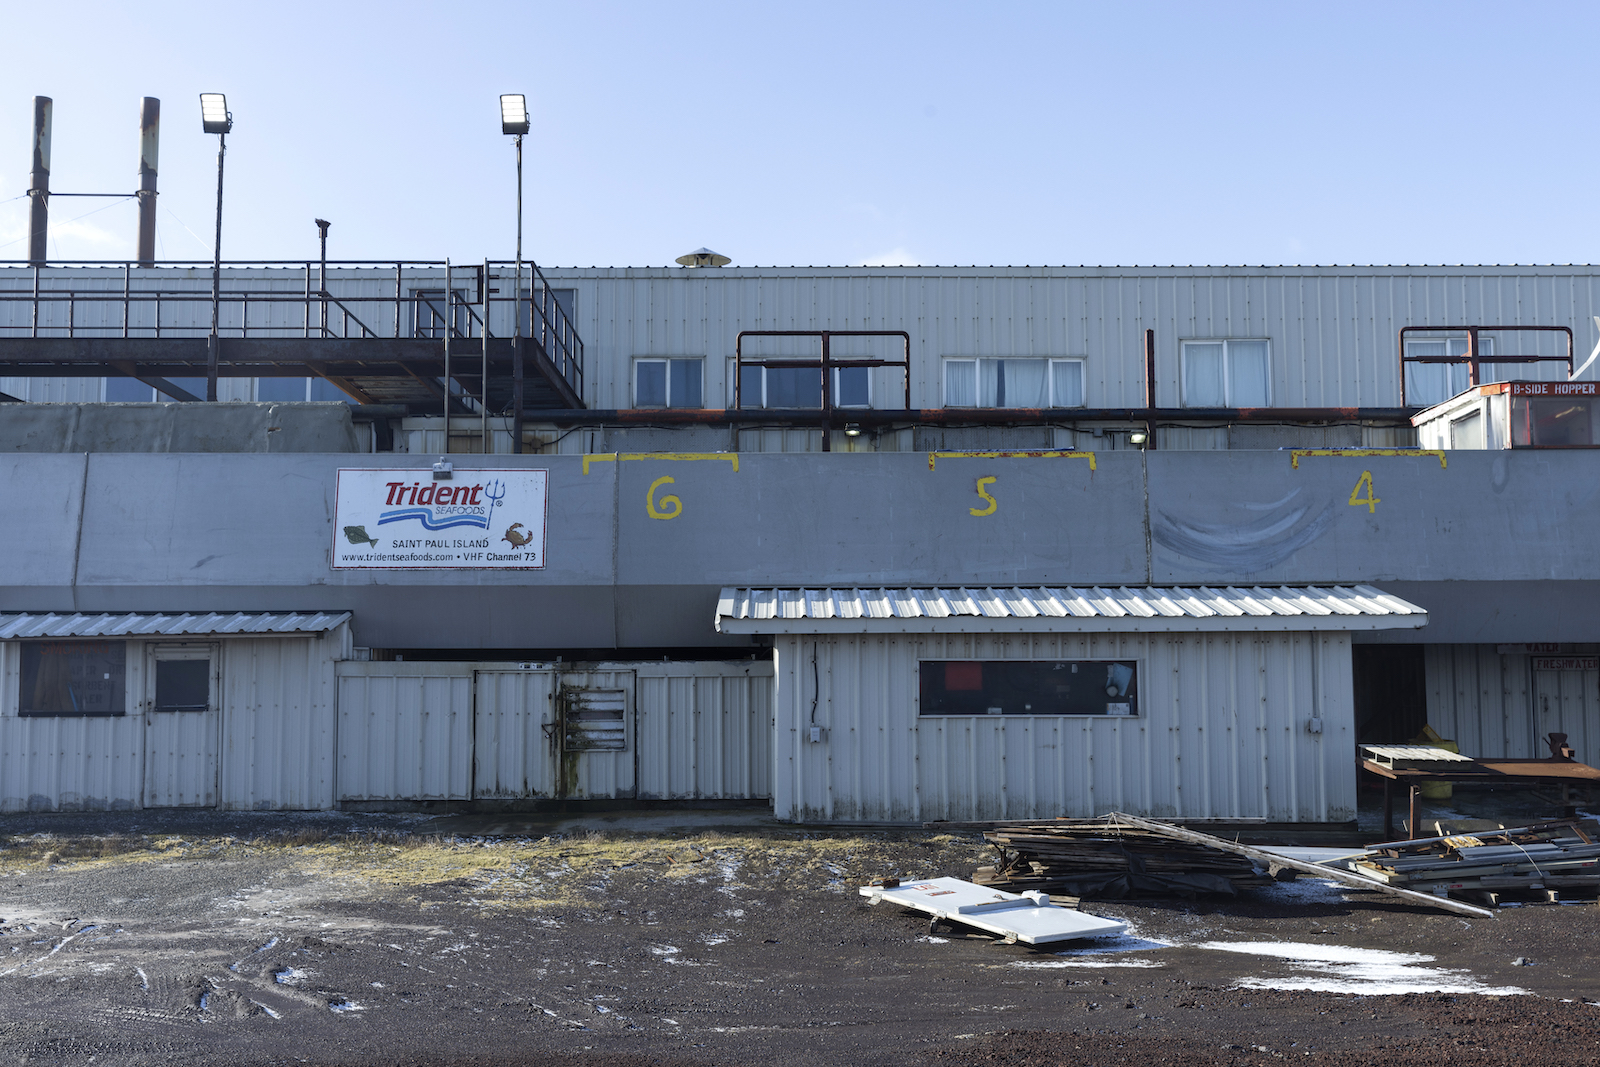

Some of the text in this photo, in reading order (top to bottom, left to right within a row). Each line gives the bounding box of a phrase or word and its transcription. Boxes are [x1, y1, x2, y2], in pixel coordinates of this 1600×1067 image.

[1514, 384, 1596, 394] B-SIDE HOPPER
[385, 481, 484, 506] Trident
[969, 475, 998, 517] 5
[1348, 470, 1381, 513] 4
[646, 475, 682, 520] 6
[435, 506, 485, 515] SEAFOODS
[392, 539, 489, 548] SAINT PAUL ISLAND
[341, 552, 536, 562] www.tridentseafoods.com VHF Channel 73
[40, 641, 109, 656] SMOKING
[1525, 643, 1559, 653] WATER
[1537, 659, 1598, 670] FRESHWATER
